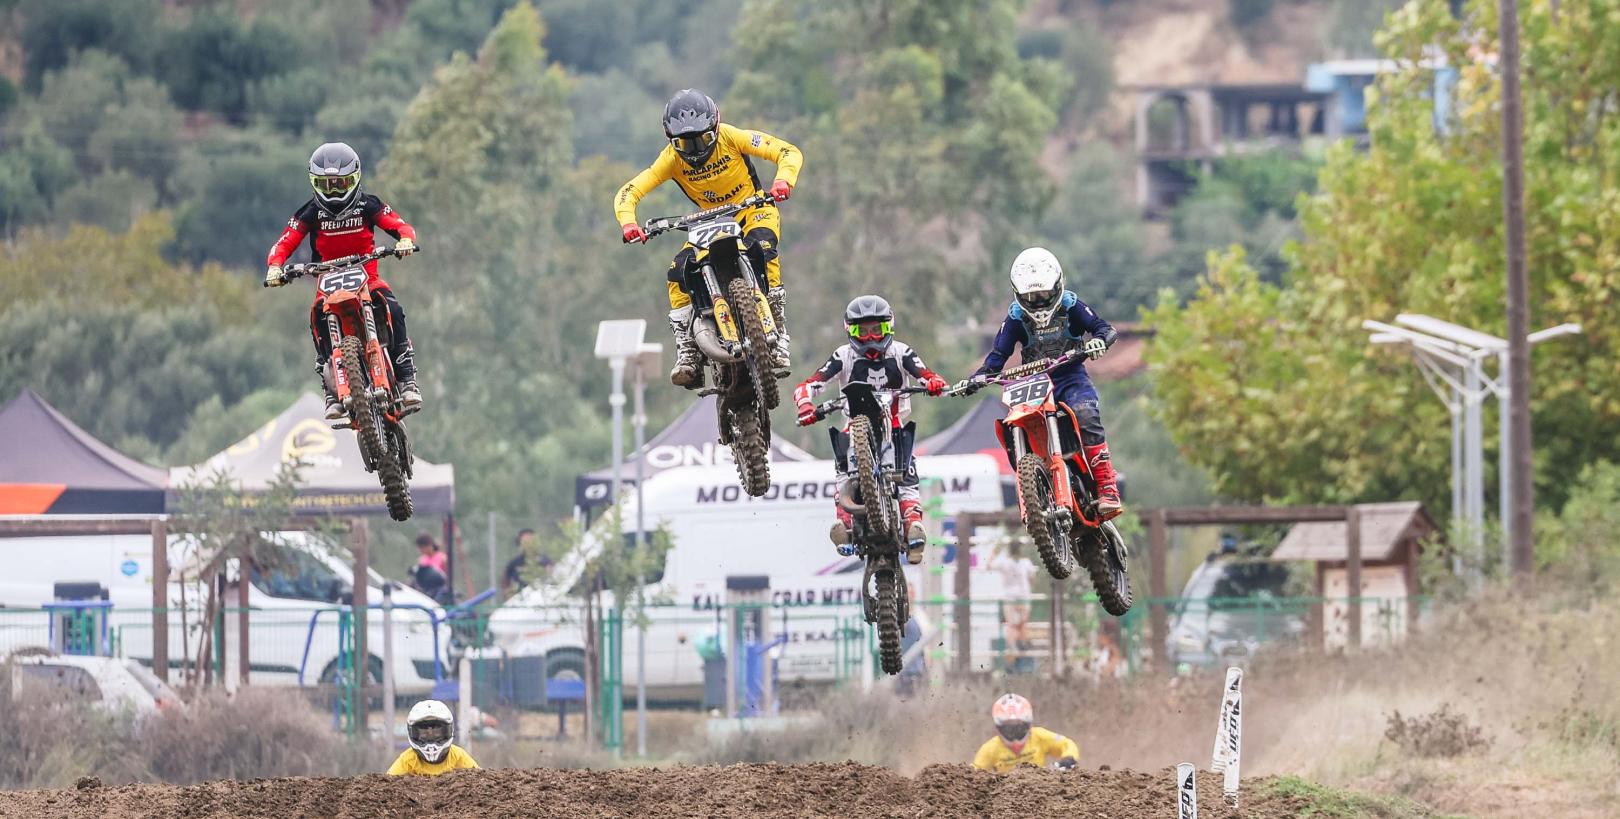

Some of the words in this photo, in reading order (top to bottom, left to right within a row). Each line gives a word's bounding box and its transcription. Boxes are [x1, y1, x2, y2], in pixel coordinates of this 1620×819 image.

[712, 164, 729, 176] TEAM
[697, 225, 735, 247] 229
[324, 271, 362, 294] 55
[1005, 359, 1047, 376] RENTHAL
[1009, 381, 1050, 407] 98
